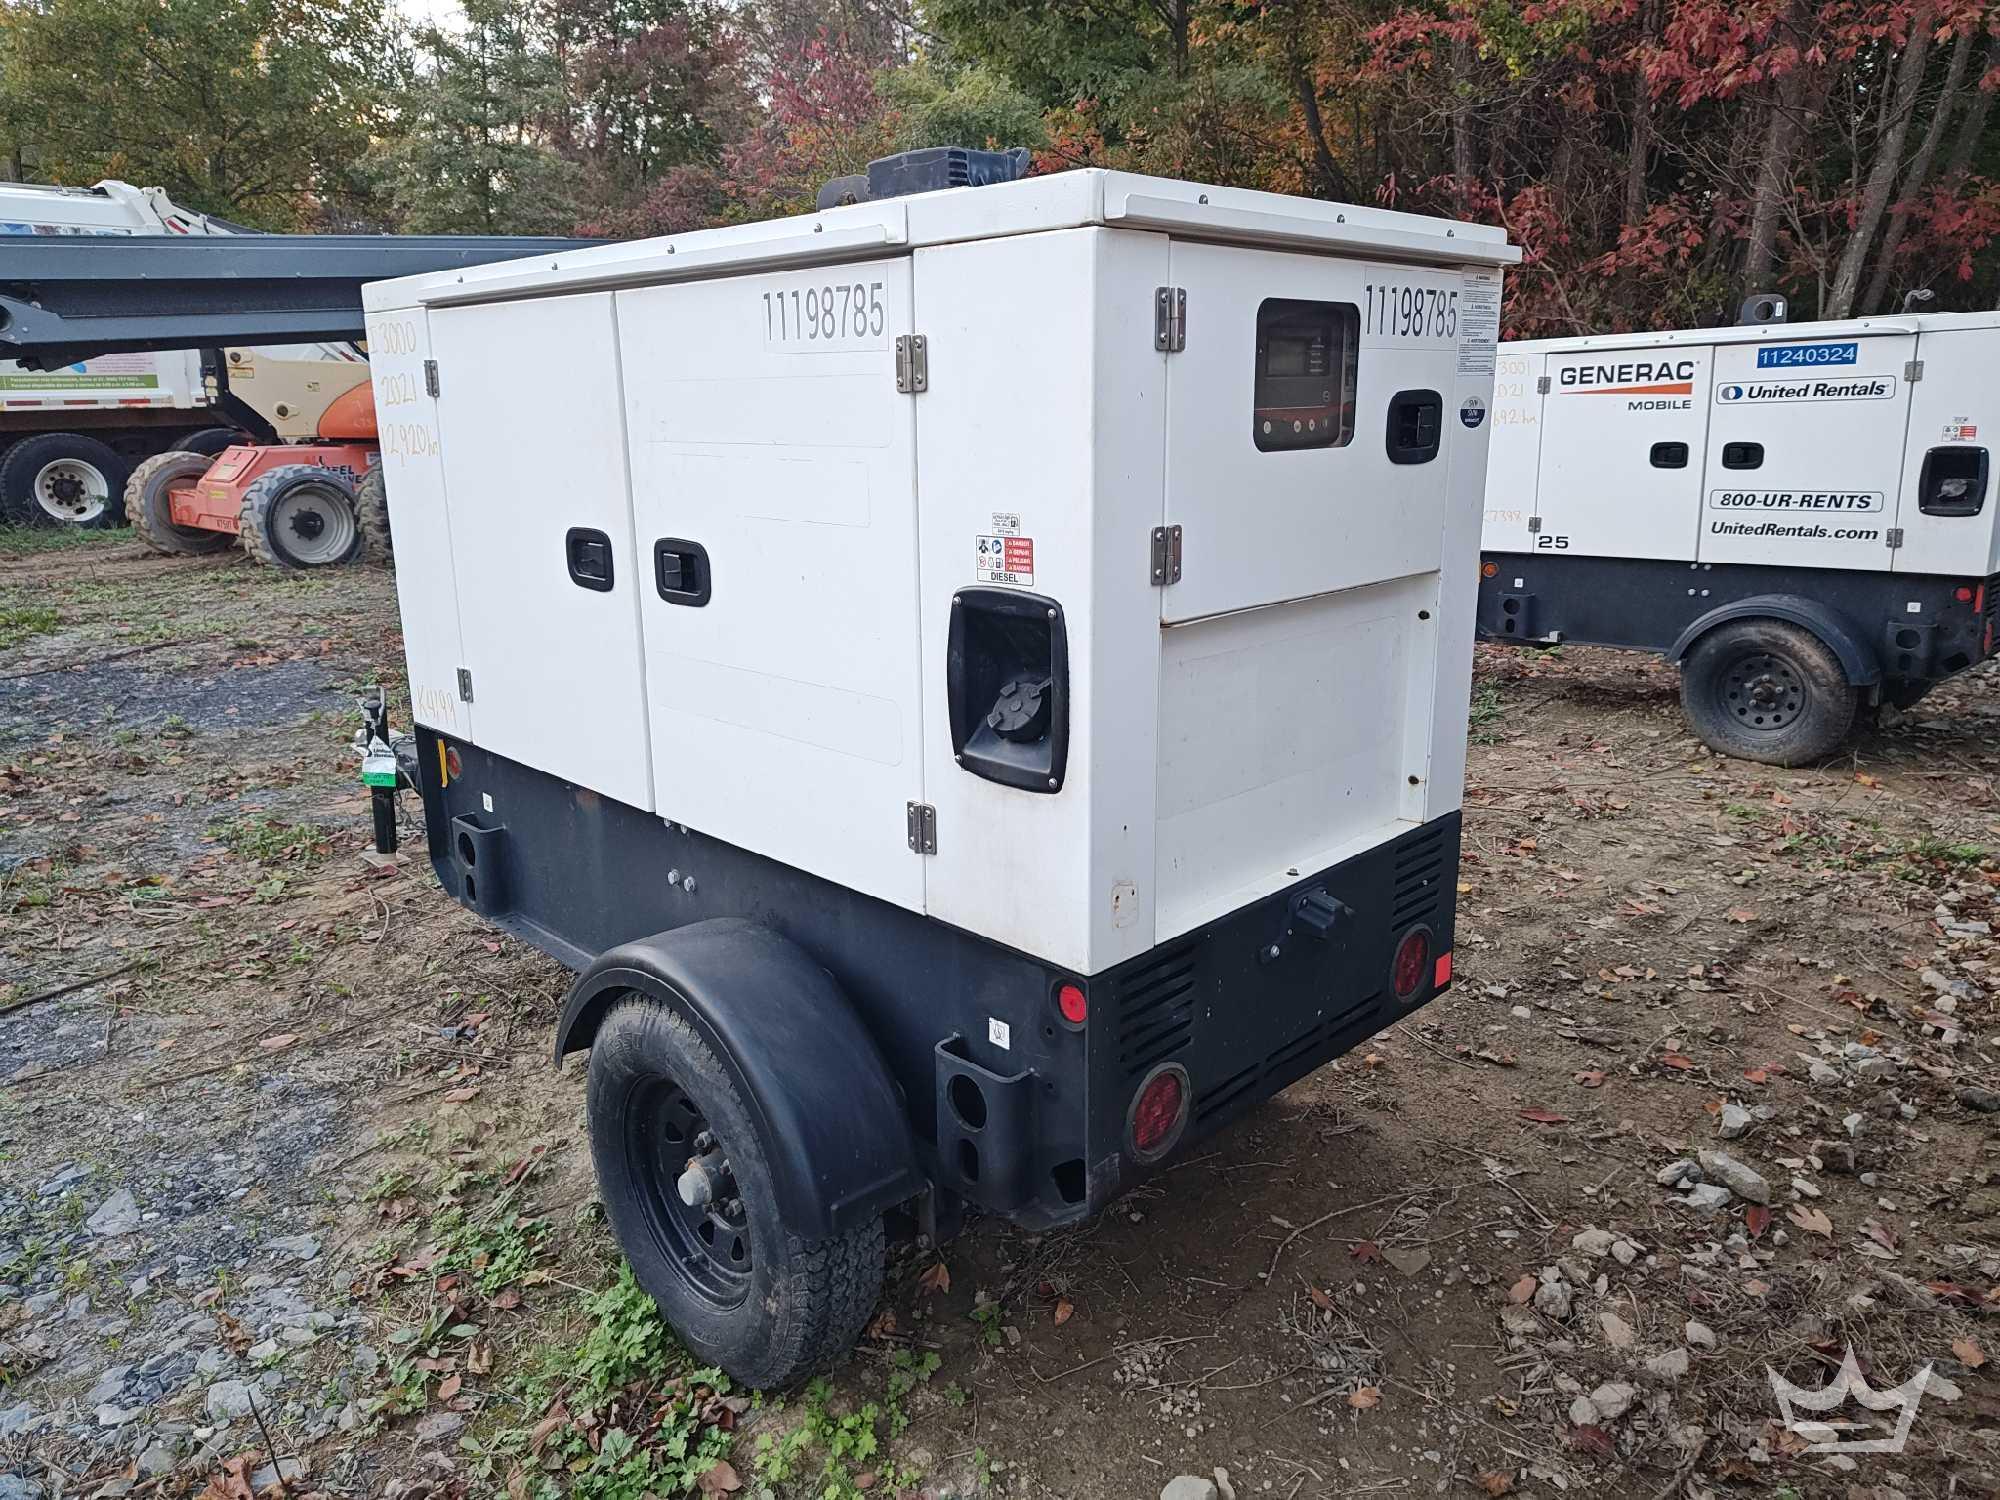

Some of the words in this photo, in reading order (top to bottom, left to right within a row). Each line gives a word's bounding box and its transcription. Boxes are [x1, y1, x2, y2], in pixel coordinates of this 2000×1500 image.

[763, 282, 884, 341] 11198785
[1366, 285, 1458, 338] 11198785
[1760, 347, 1855, 364] 11240324
[1560, 361, 1694, 385] GENERAC
[381, 373, 417, 406] 2021
[1748, 384, 1811, 399] United
[1812, 380, 1886, 397] Rentals
[1628, 400, 1692, 410] MOBILE
[1720, 493, 1872, 509] 800-UR-RENTS
[1711, 521, 1879, 540] UnitedRentals.com
[1538, 536, 1569, 549] 25
[991, 571, 1019, 583] DIESEL
